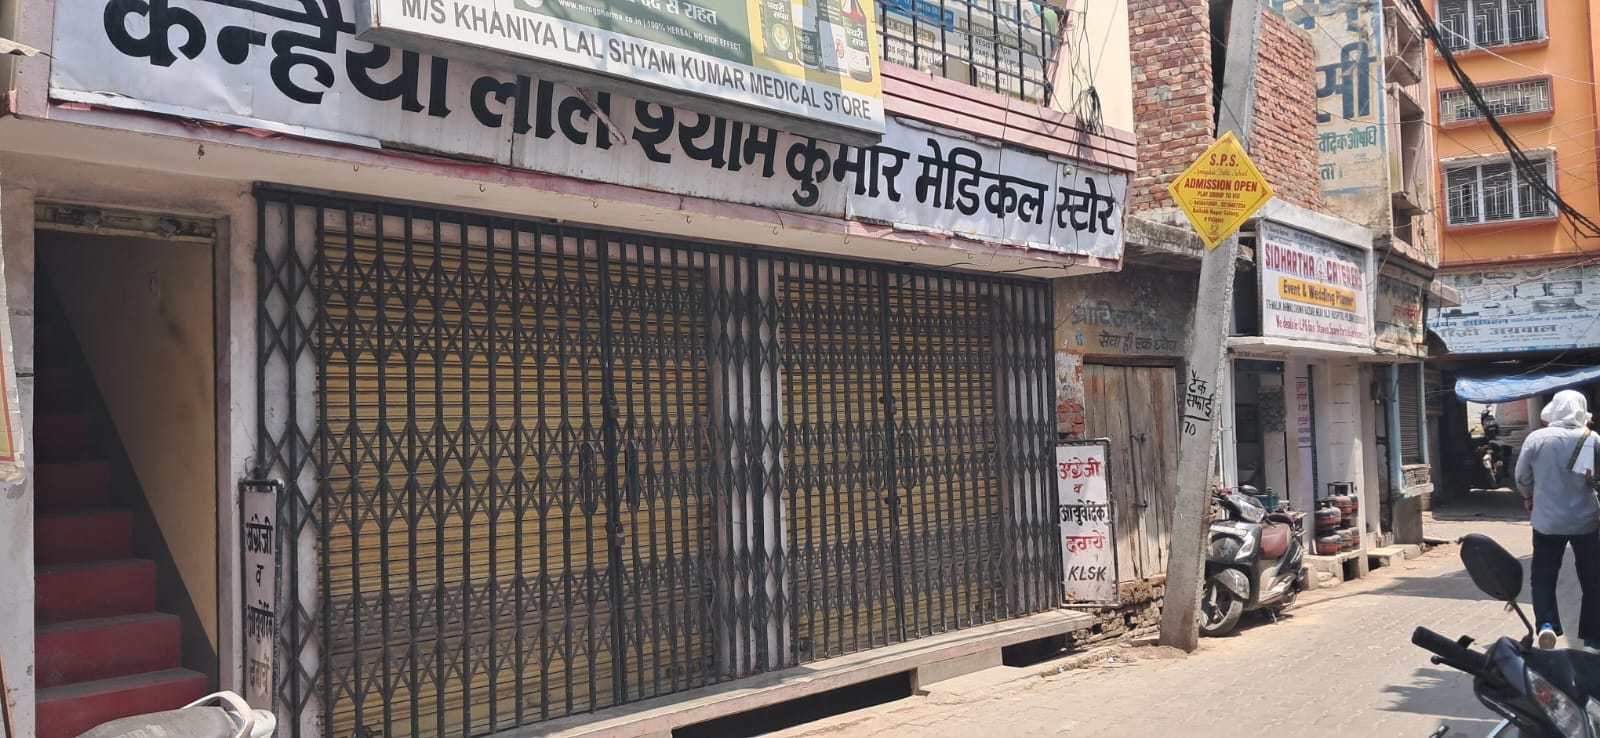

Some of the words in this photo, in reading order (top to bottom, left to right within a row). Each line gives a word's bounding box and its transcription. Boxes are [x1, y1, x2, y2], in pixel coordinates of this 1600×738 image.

[683, 2, 717, 25] राहत
[667, 25, 692, 38] HERBAL
[693, 31, 703, 40] NO
[704, 34, 719, 45] SIDE
[719, 38, 742, 52] EFFECT
[401, 0, 446, 24] M/S
[454, 2, 558, 48] KHANIYA
[563, 27, 604, 60] LAL
[609, 38, 676, 77] SHYAM
[682, 55, 746, 92] KUMAR
[749, 71, 821, 109] MEDICAL
[823, 90, 872, 121] STORE
[469, 75, 613, 150] लाल
[785, 136, 910, 207] कुमार
[915, 138, 1049, 225] मेडिकल
[1056, 177, 1116, 236] स्टोर
[1209, 153, 1239, 168] S.P.S.
[1184, 178, 1232, 191] ADMISSION
[1233, 180, 1258, 193] OPEN
[1265, 242, 1315, 279] SIDHARTHA
[1283, 279, 1301, 297] Event
[1302, 283, 1307, 297] &
[1308, 284, 1335, 306] Wedding
[1122, 331, 1135, 353] ही
[1187, 393, 1214, 418] सफाई
[1185, 421, 1196, 436] 70
[1058, 456, 1101, 480] अंग्रेजी
[1073, 483, 1084, 494] व
[255, 564, 264, 588] व
[1068, 566, 1107, 581] KLSK
